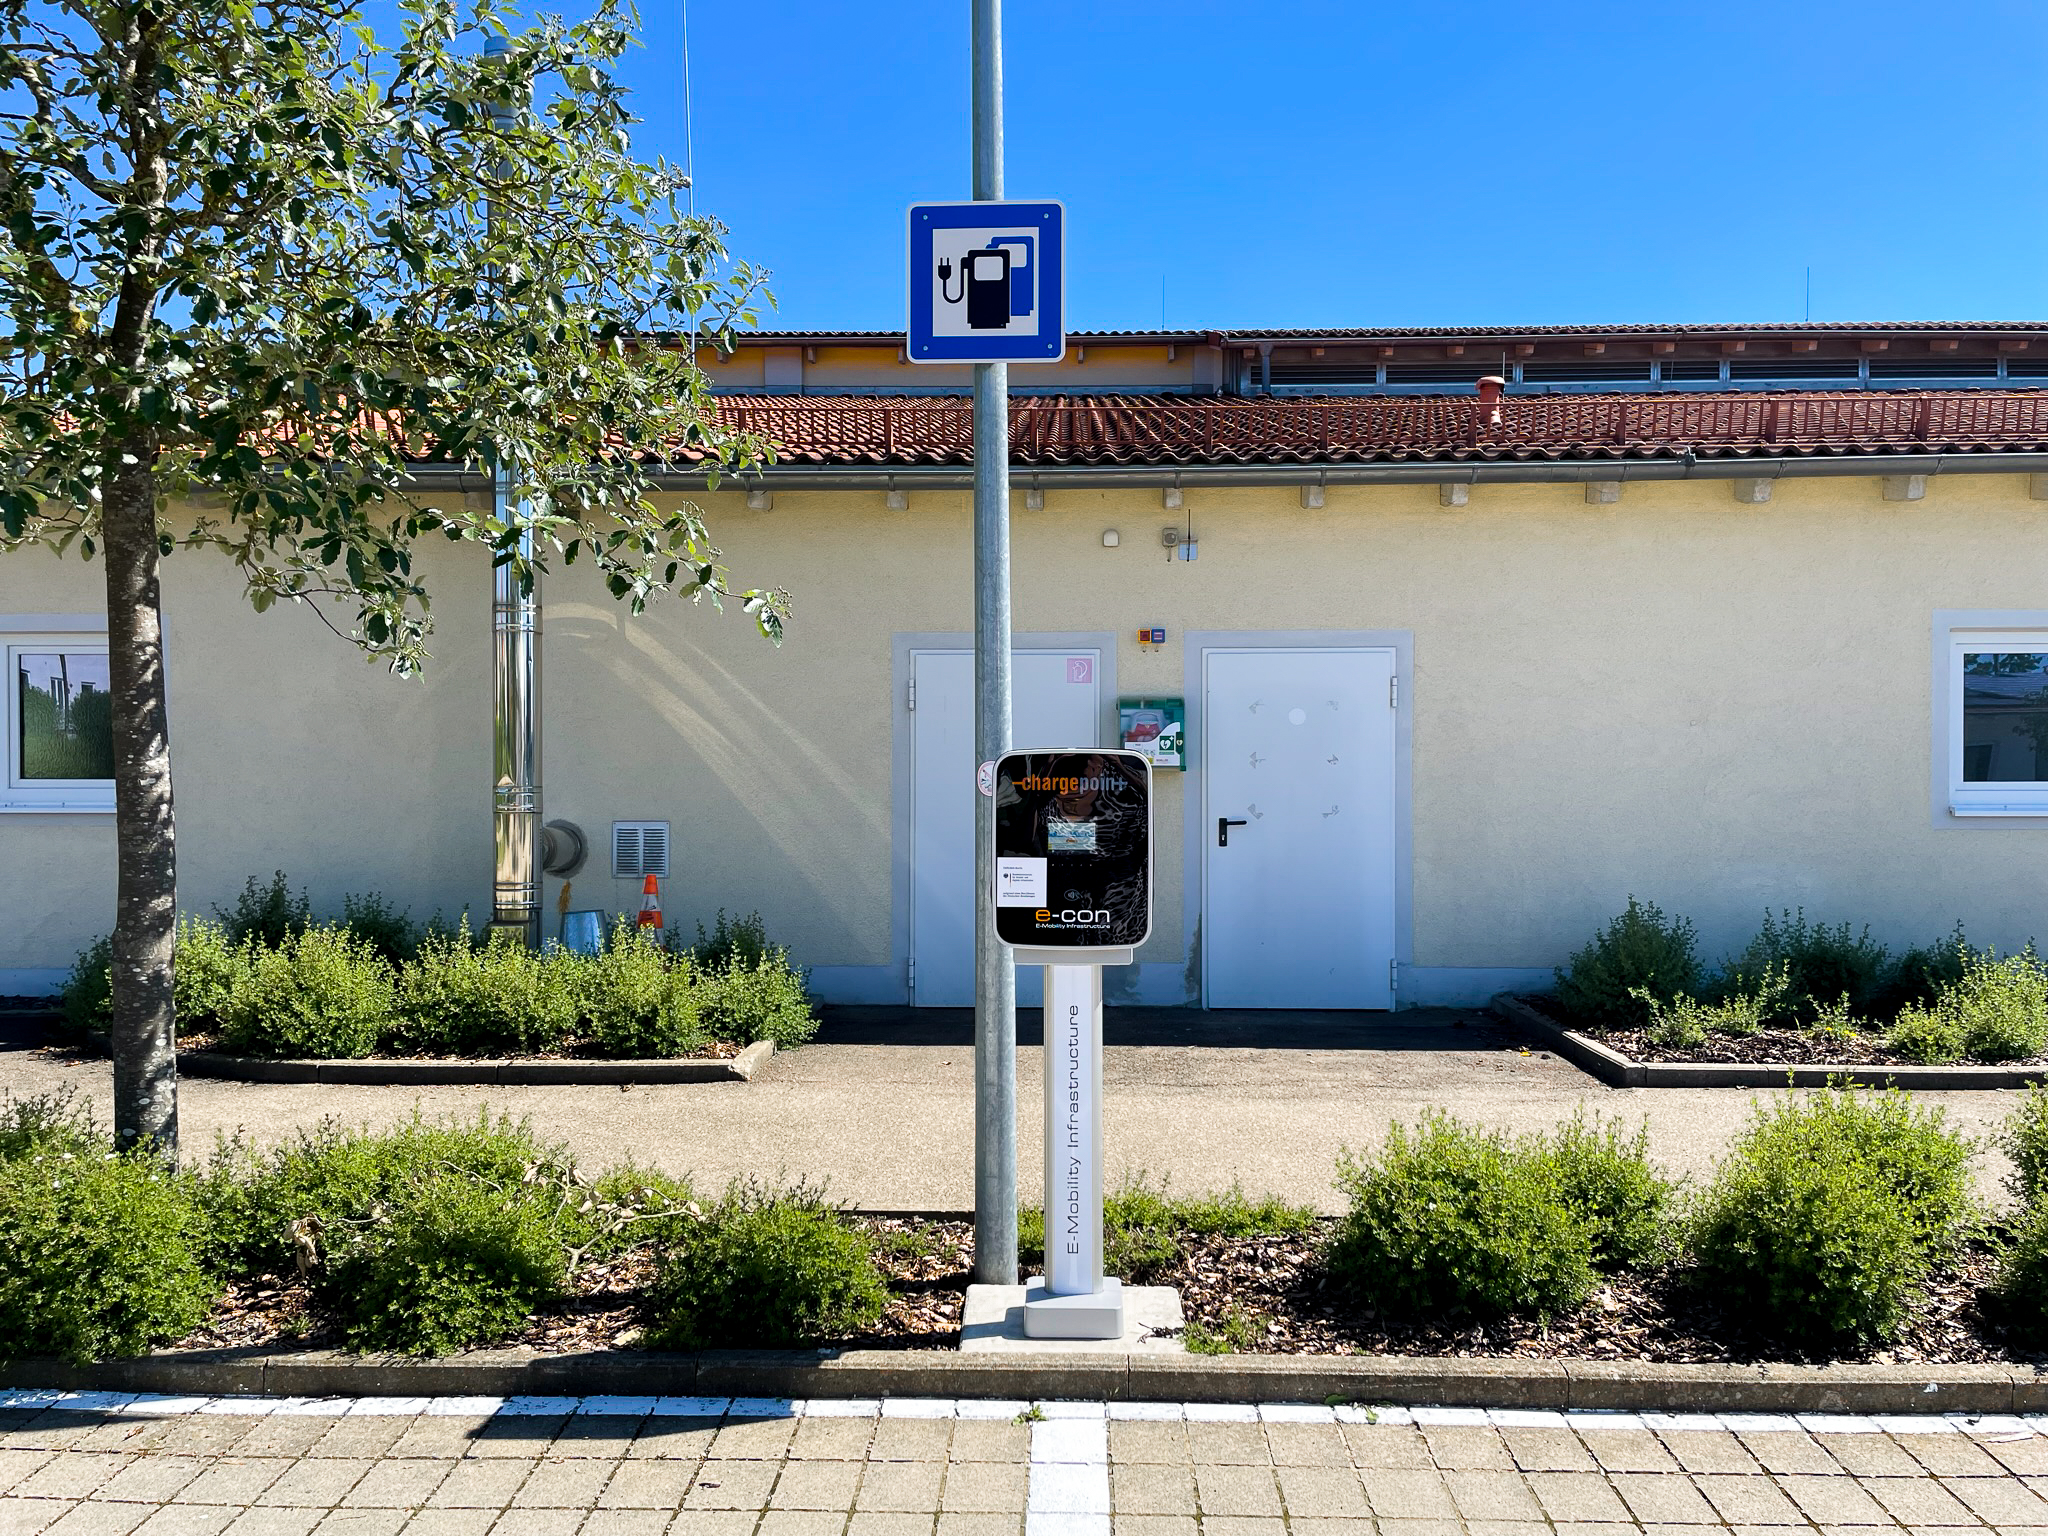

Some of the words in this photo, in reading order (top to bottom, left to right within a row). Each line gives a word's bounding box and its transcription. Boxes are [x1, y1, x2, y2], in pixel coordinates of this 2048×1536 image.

[1035, 909, 1110, 923] e-con
[1067, 1005, 1079, 1149] Infrastructure
[1067, 1156, 1081, 1254] E-Mobility
